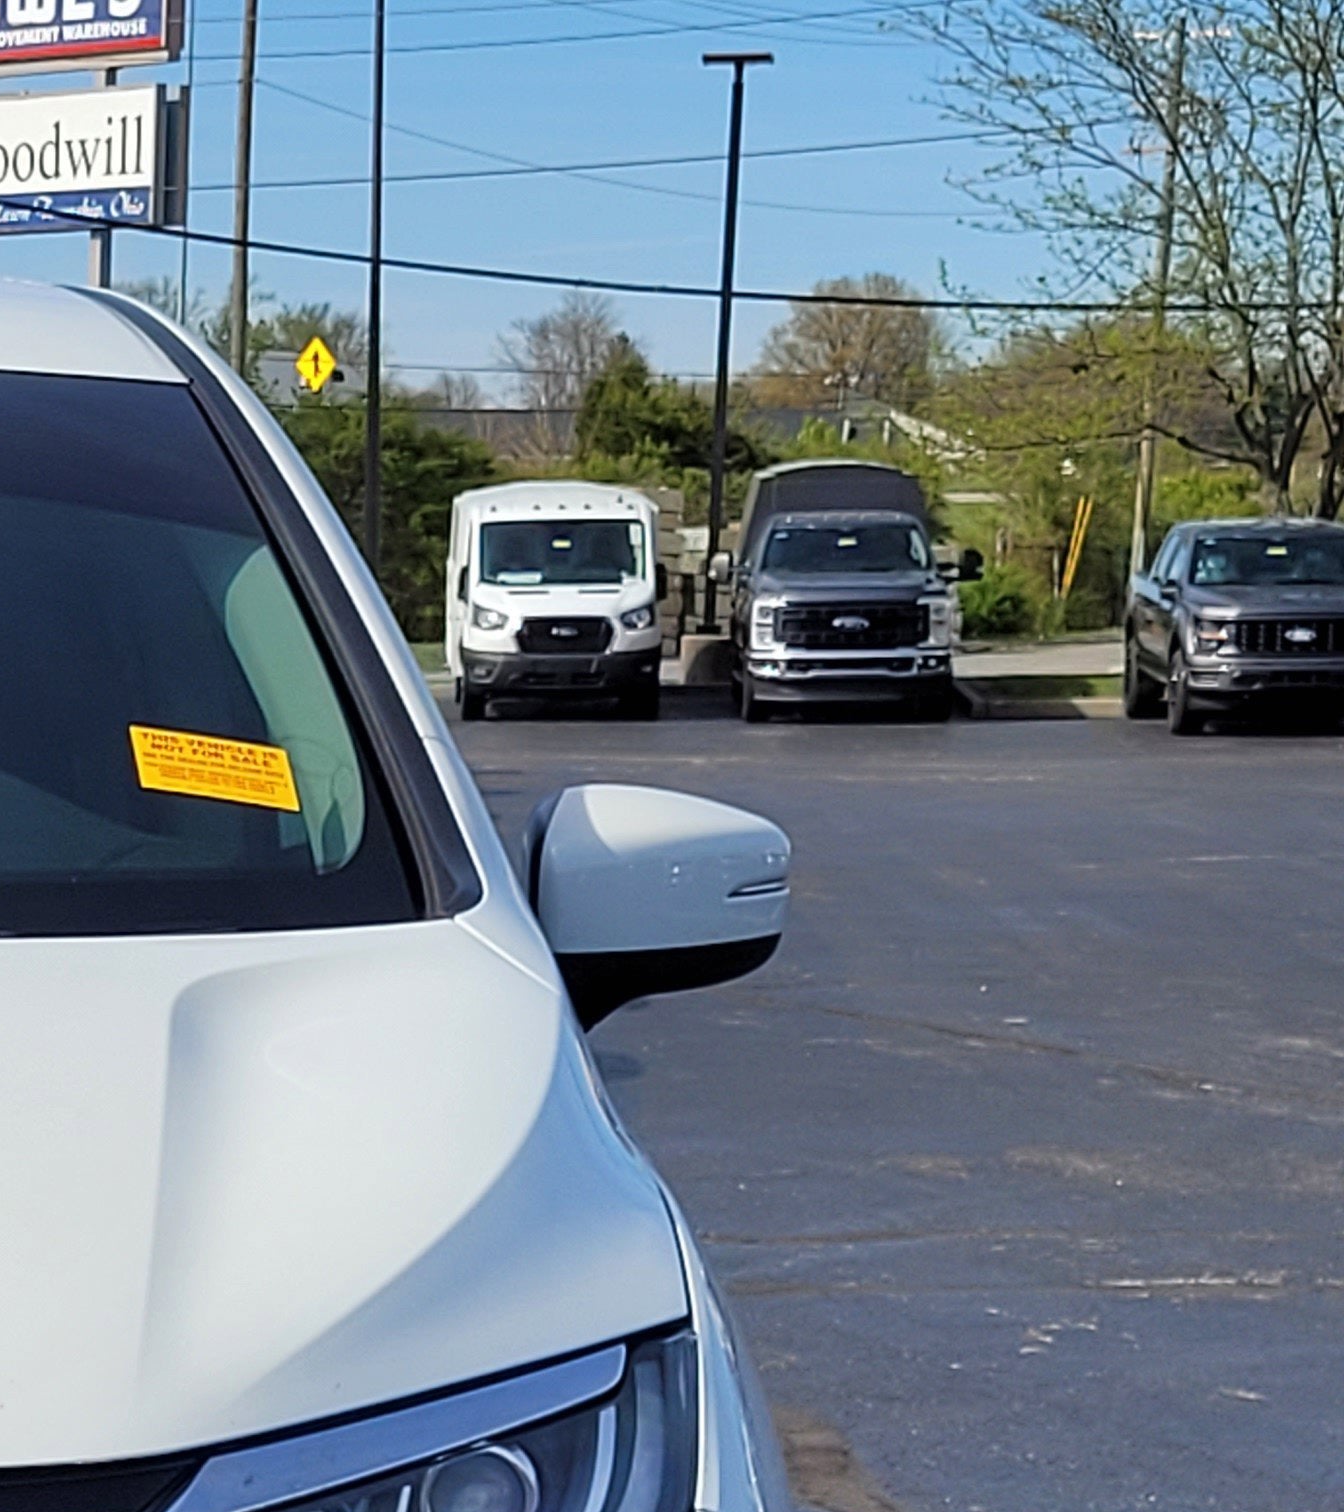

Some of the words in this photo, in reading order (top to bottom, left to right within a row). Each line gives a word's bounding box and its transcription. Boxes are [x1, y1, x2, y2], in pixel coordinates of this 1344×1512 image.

[62, 17, 148, 42] WAREHOUSE
[142, 732, 180, 745] THIS
[186, 738, 256, 756] VEHICLE
[262, 751, 279, 761] IS
[150, 742, 184, 754] NOT
[191, 748, 225, 760] FOR
[230, 753, 273, 768] SALE
